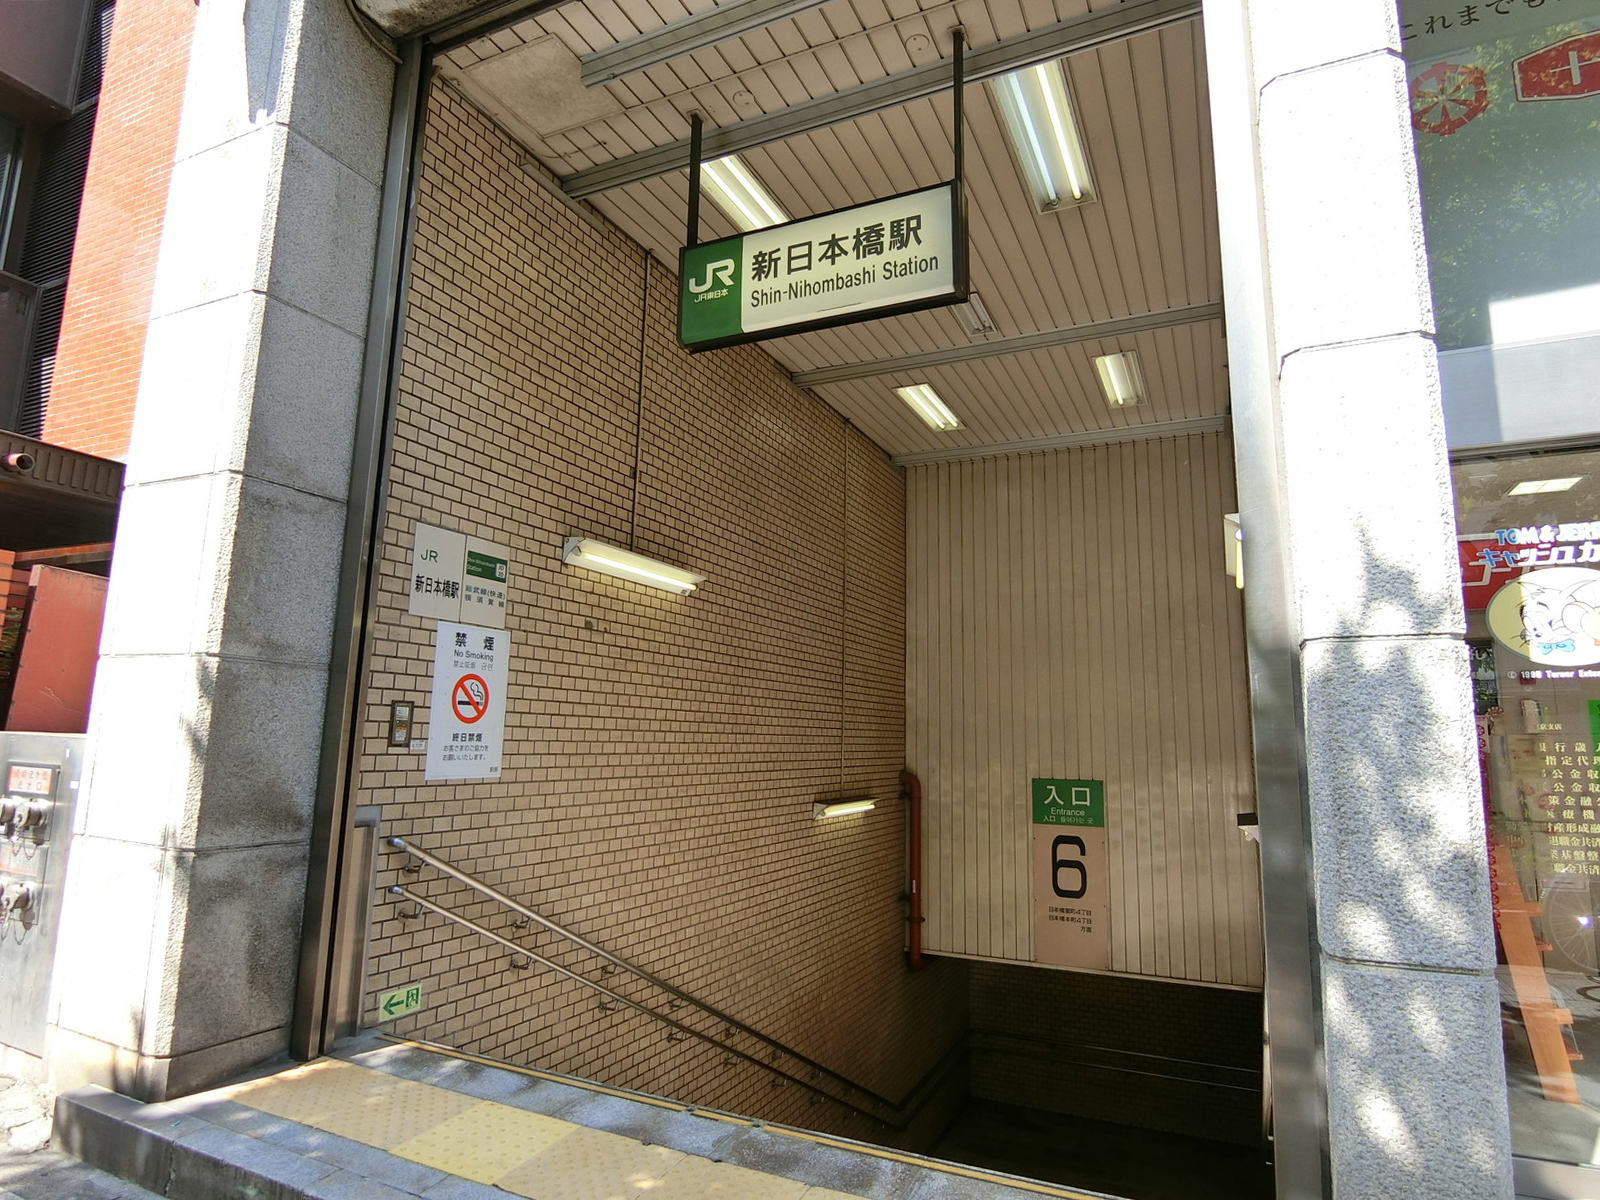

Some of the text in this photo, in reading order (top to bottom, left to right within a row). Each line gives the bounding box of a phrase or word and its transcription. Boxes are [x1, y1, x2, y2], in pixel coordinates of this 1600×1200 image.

[751, 214, 922, 282] 新日本橋駅
[688, 258, 735, 294] JR
[751, 256, 939, 308] Shin-Nihombashi Station
[694, 288, 729, 303] JR東日本
[1495, 526, 1540, 546] TOM
[420, 549, 438, 563] JR
[415, 574, 459, 599] 新日本橋駅
[455, 632, 495, 651] 禁煙
[454, 649, 494, 662] No Smoking
[1044, 786, 1090, 806] 入口
[1051, 807, 1085, 816] Entrance
[1052, 834, 1087, 899] 6
[1049, 915, 1092, 924] 日本橋本町4丁目
